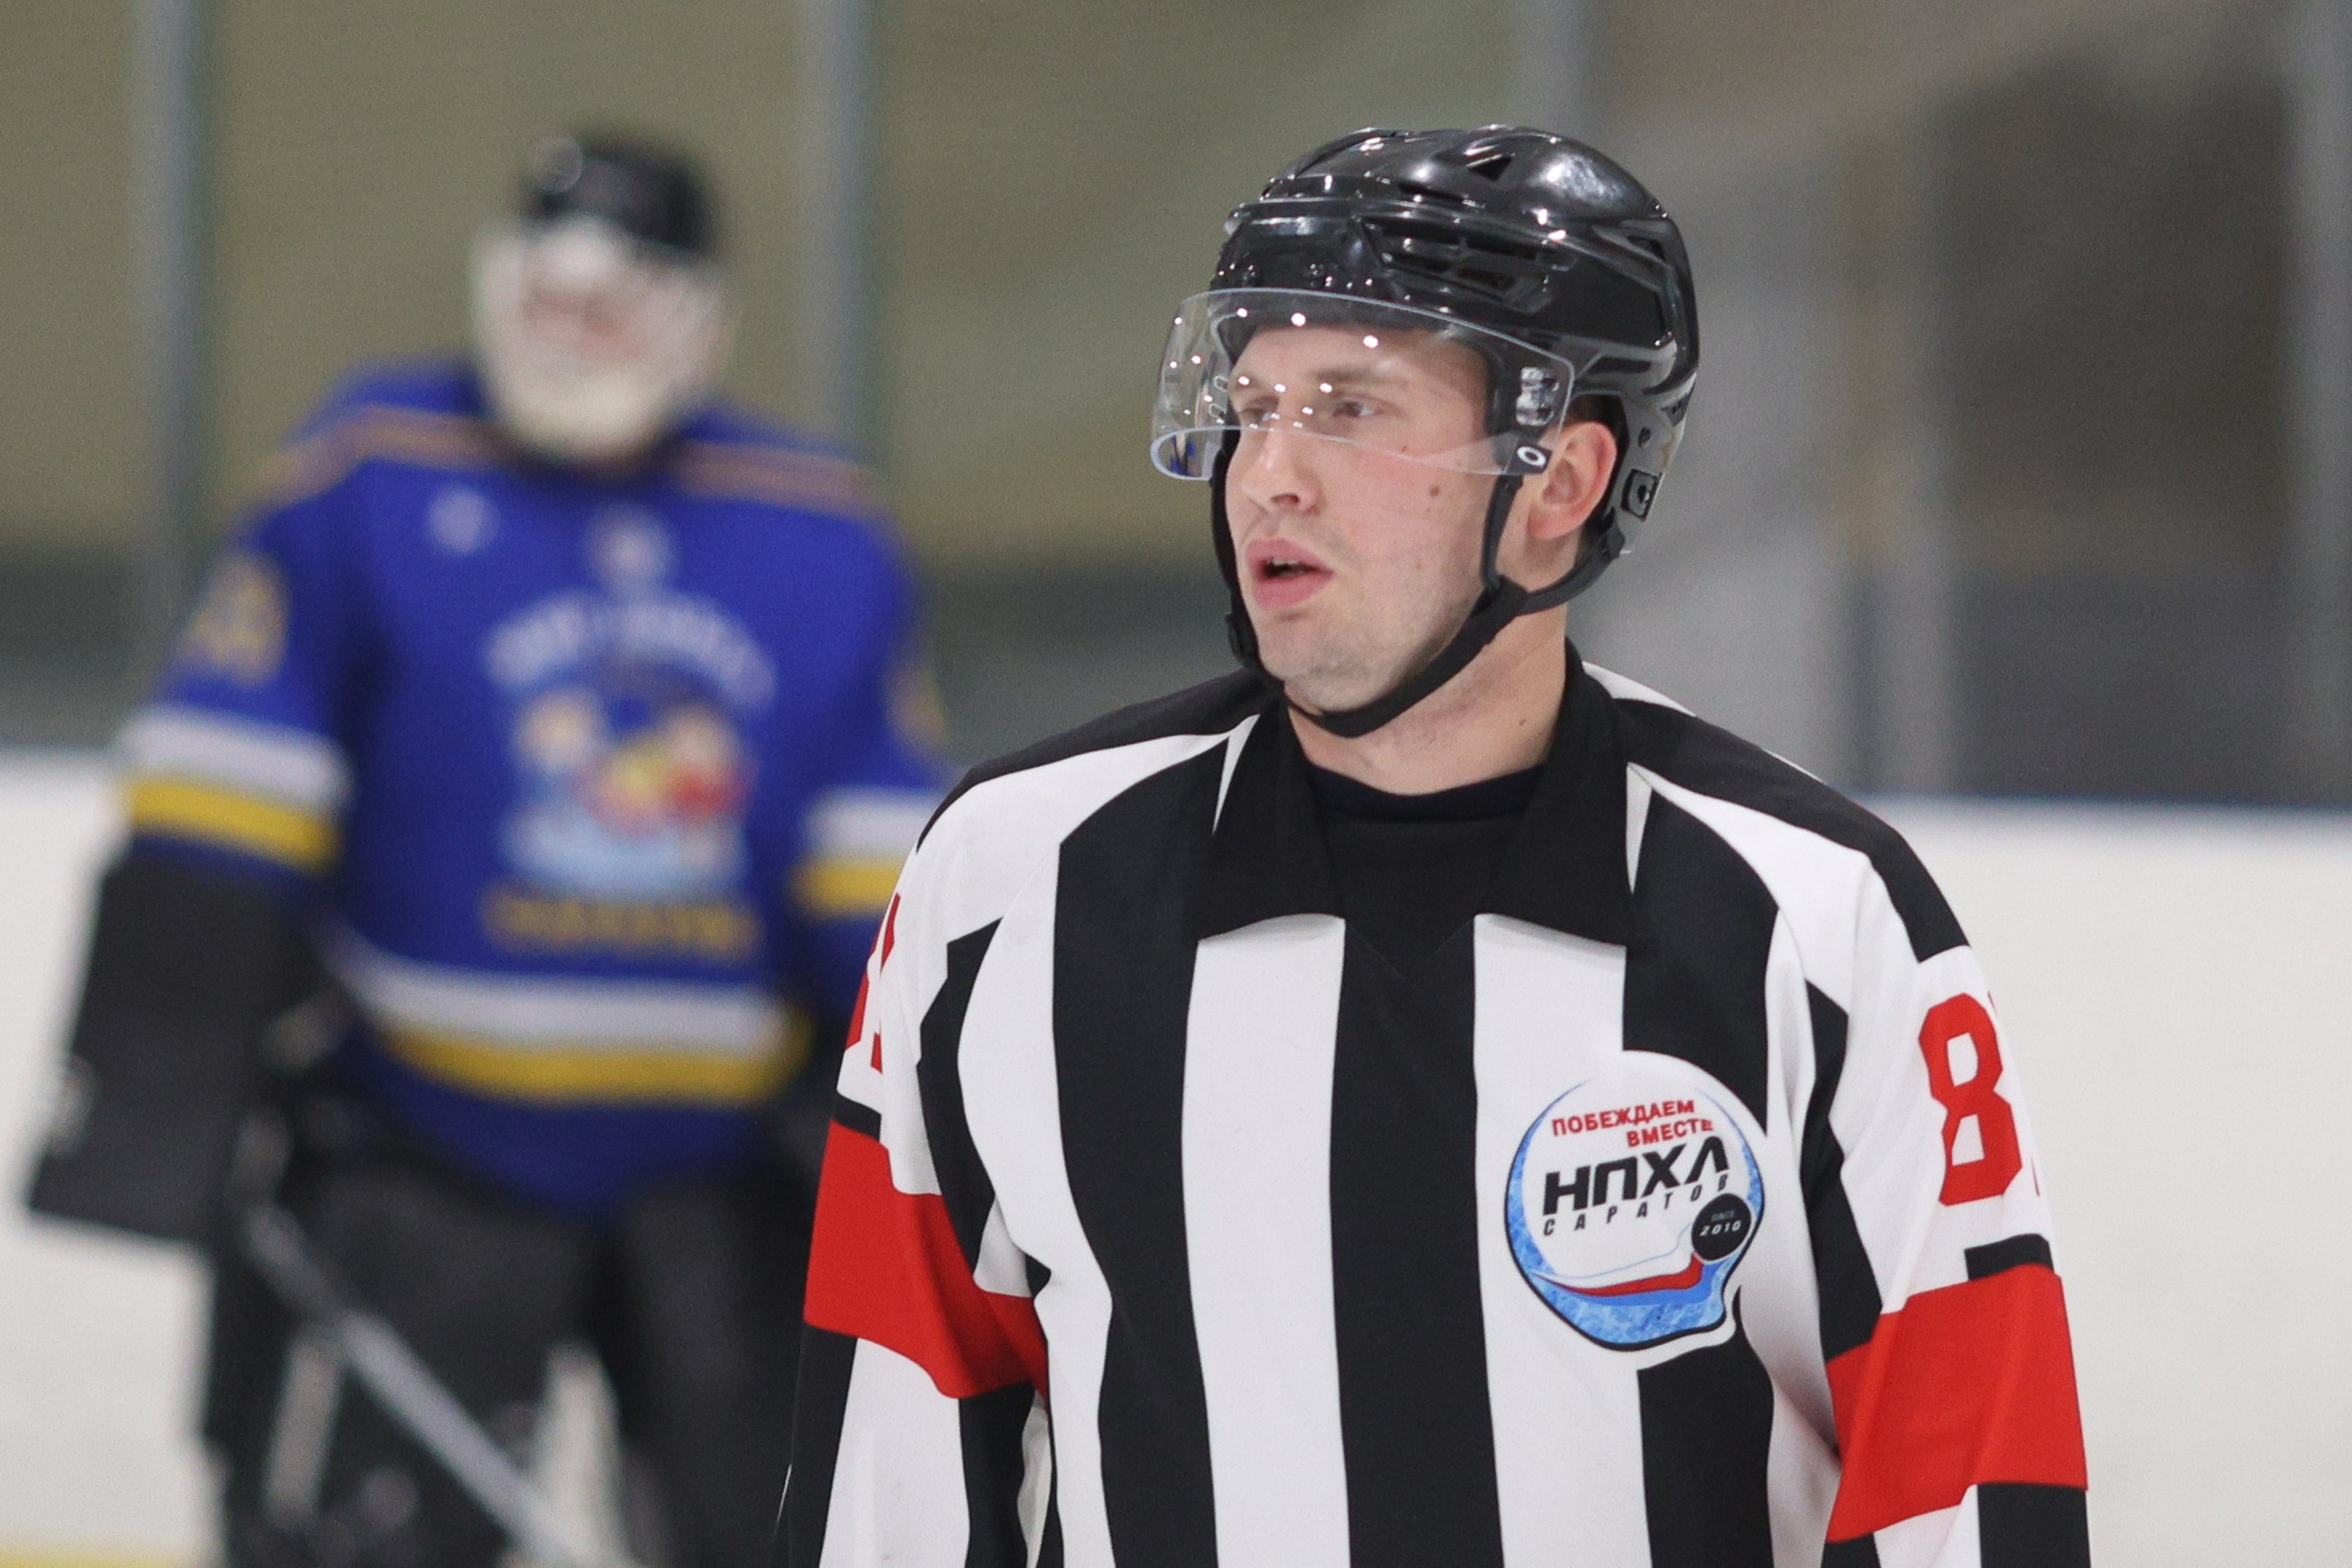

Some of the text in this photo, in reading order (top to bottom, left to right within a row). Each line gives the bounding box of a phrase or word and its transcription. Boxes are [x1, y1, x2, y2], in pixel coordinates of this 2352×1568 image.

[1551, 1100, 1695, 1137] ПОБЕЖДАЕМ
[1918, 990, 2041, 1207] 8
[1625, 1118, 1714, 1148] ВМЕСТЕ
[1543, 1135, 1730, 1216] НПХЛ
[1543, 1173, 1730, 1236] САРАТОВ
